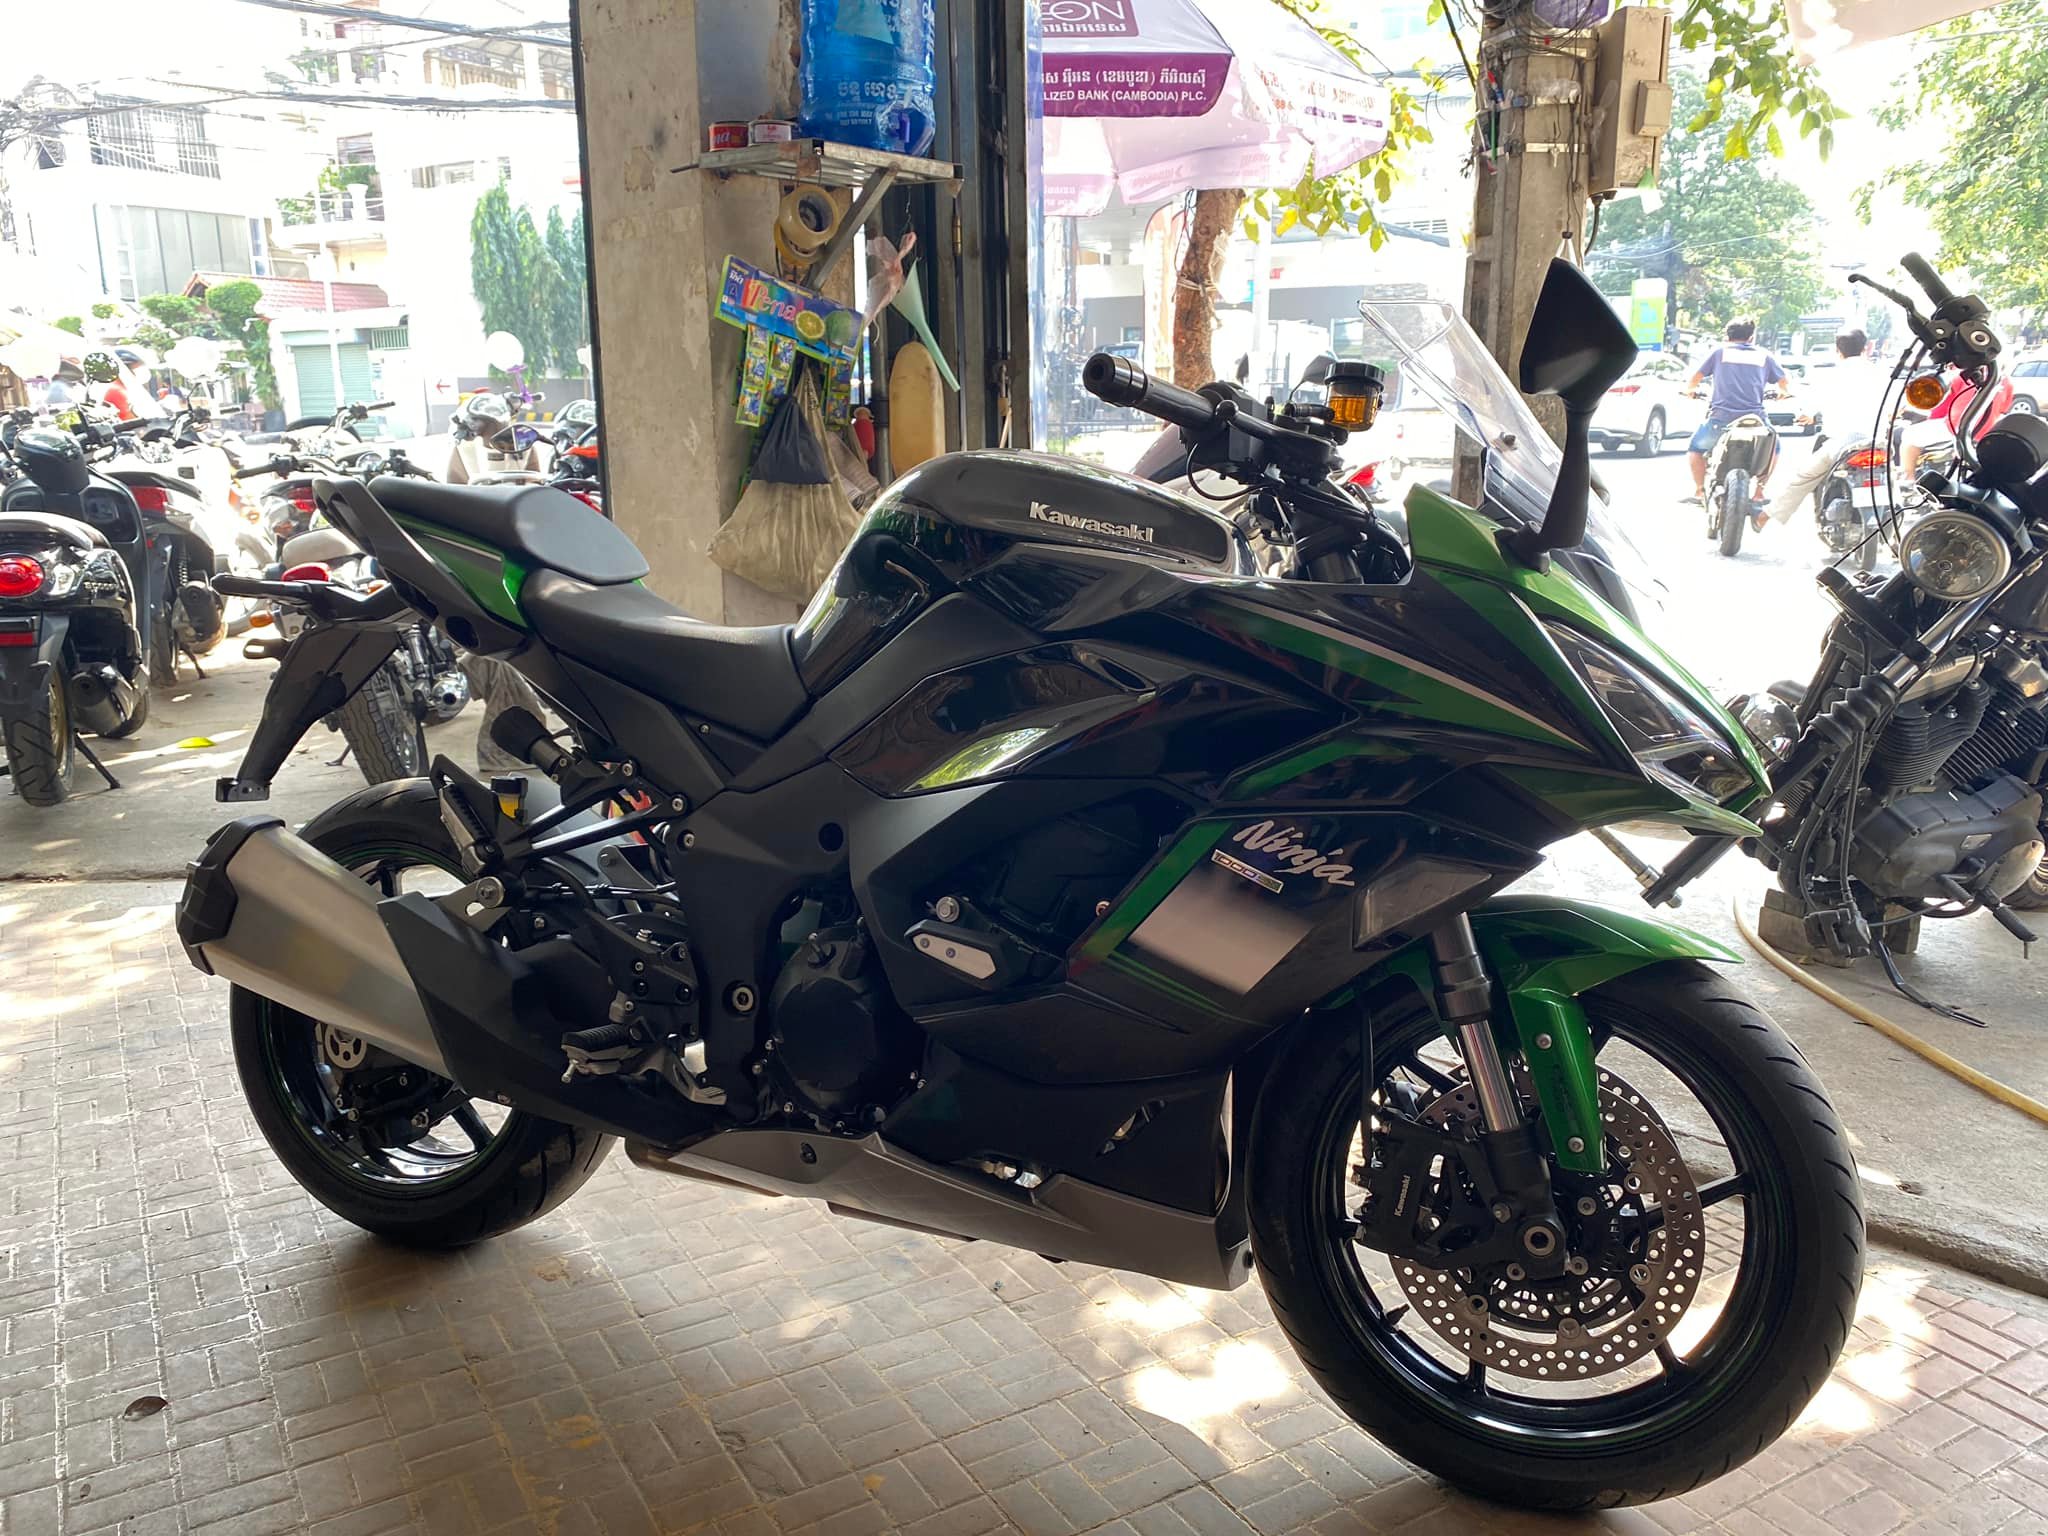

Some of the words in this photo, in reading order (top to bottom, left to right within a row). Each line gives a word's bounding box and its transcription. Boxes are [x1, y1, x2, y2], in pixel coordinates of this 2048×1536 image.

[1077, 90, 1109, 100] BANK
[1111, 90, 1179, 103] (CAMBODIA)
[1181, 90, 1207, 101] PLC.
[1029, 500, 1154, 543] Kawasaki
[1232, 820, 1356, 887] Ninja
[1394, 1174, 1412, 1217] Kawasaki
